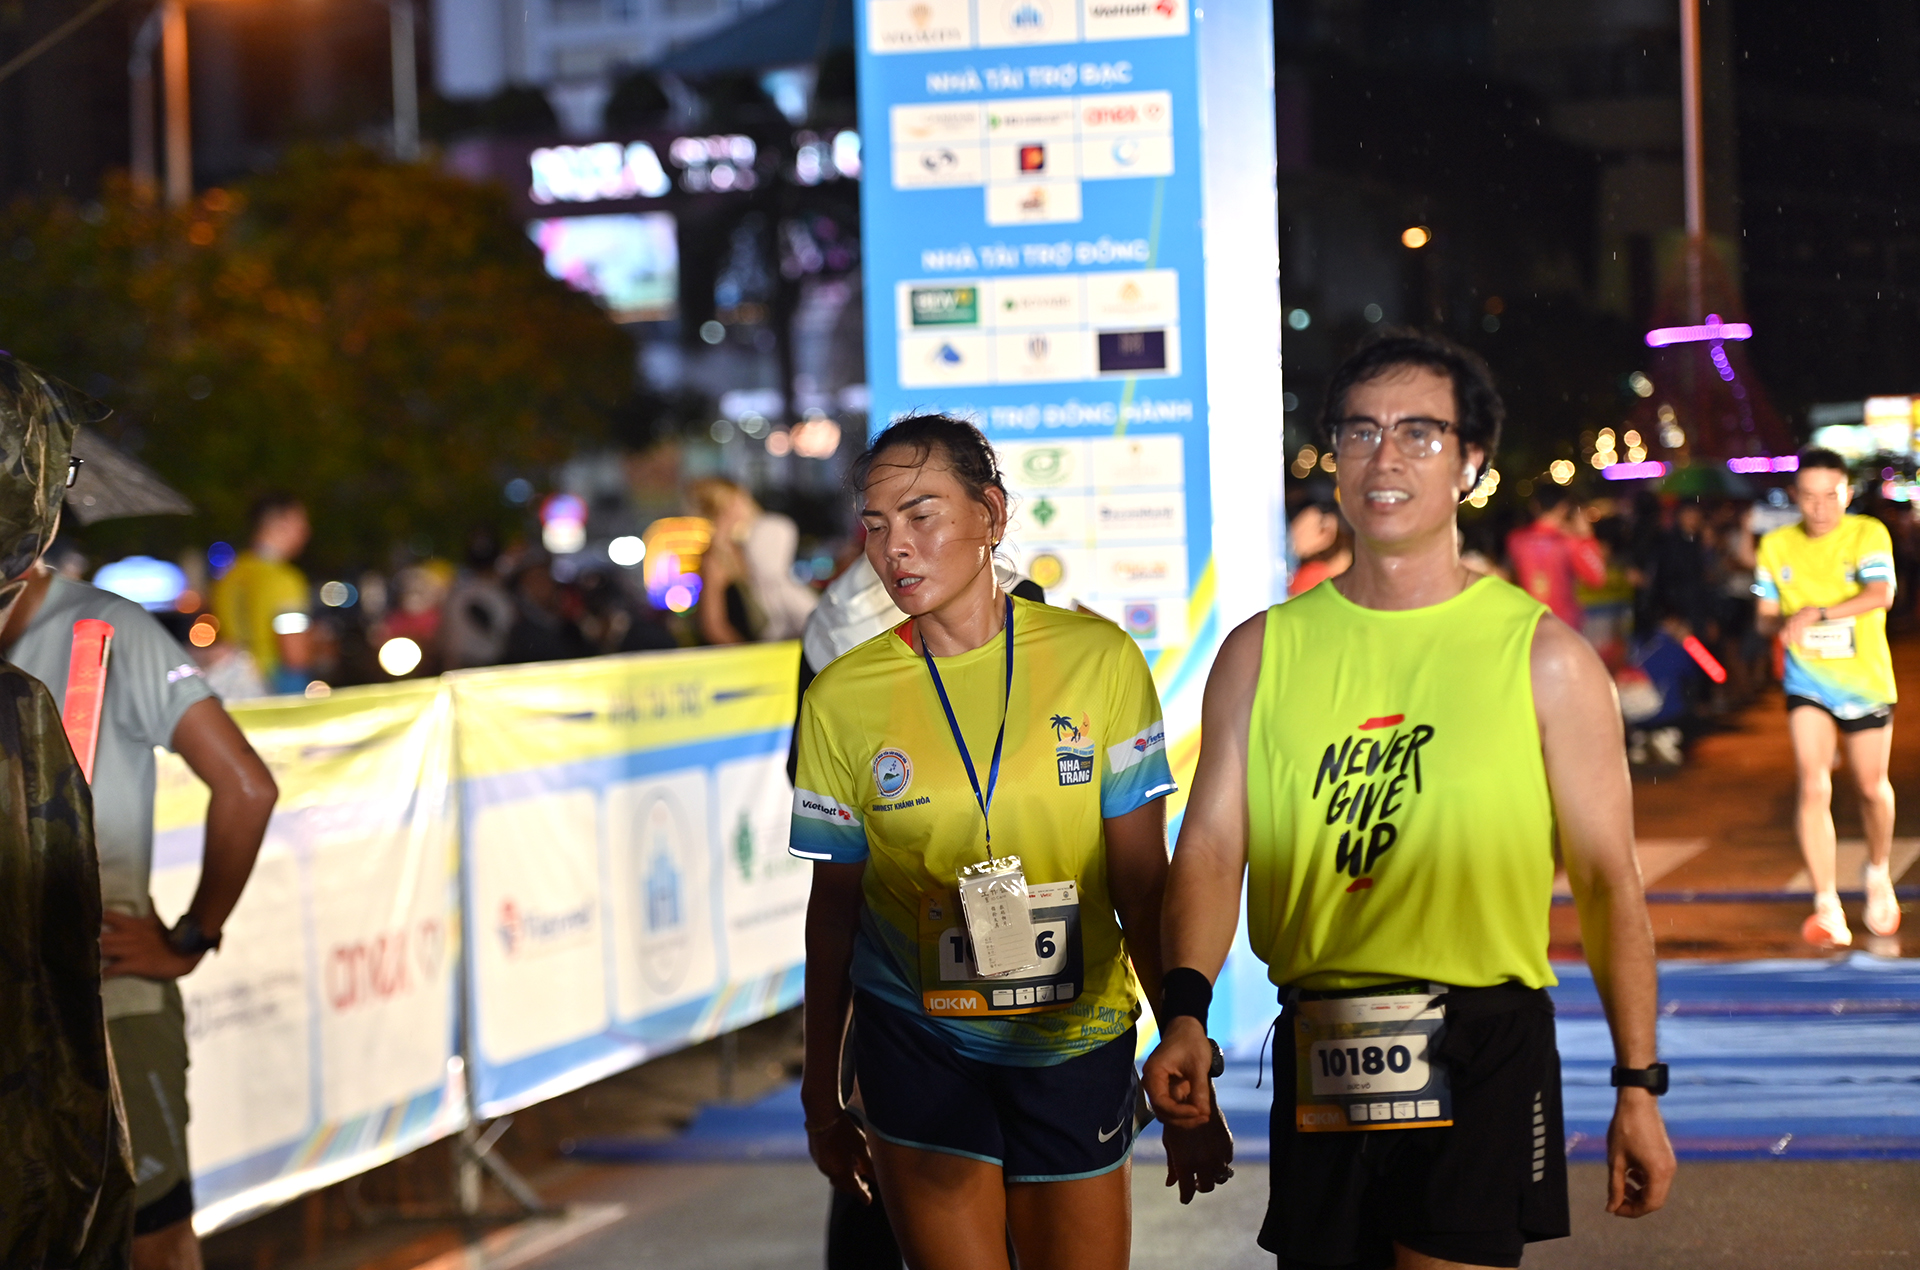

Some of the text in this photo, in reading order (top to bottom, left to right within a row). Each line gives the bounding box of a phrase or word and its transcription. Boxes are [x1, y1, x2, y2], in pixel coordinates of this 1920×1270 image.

[1059, 759, 1080, 772] NHA
[1312, 725, 1435, 799] NEVER
[1060, 769, 1090, 784] TRANG
[802, 800, 837, 815] Vietlott
[916, 796, 931, 806] HÒA
[1326, 774, 1408, 831] GIVE
[1336, 822, 1397, 878] UP
[930, 997, 977, 1010] 10KM
[1318, 1045, 1412, 1077] 10180
[1302, 1112, 1340, 1125] 10KM
